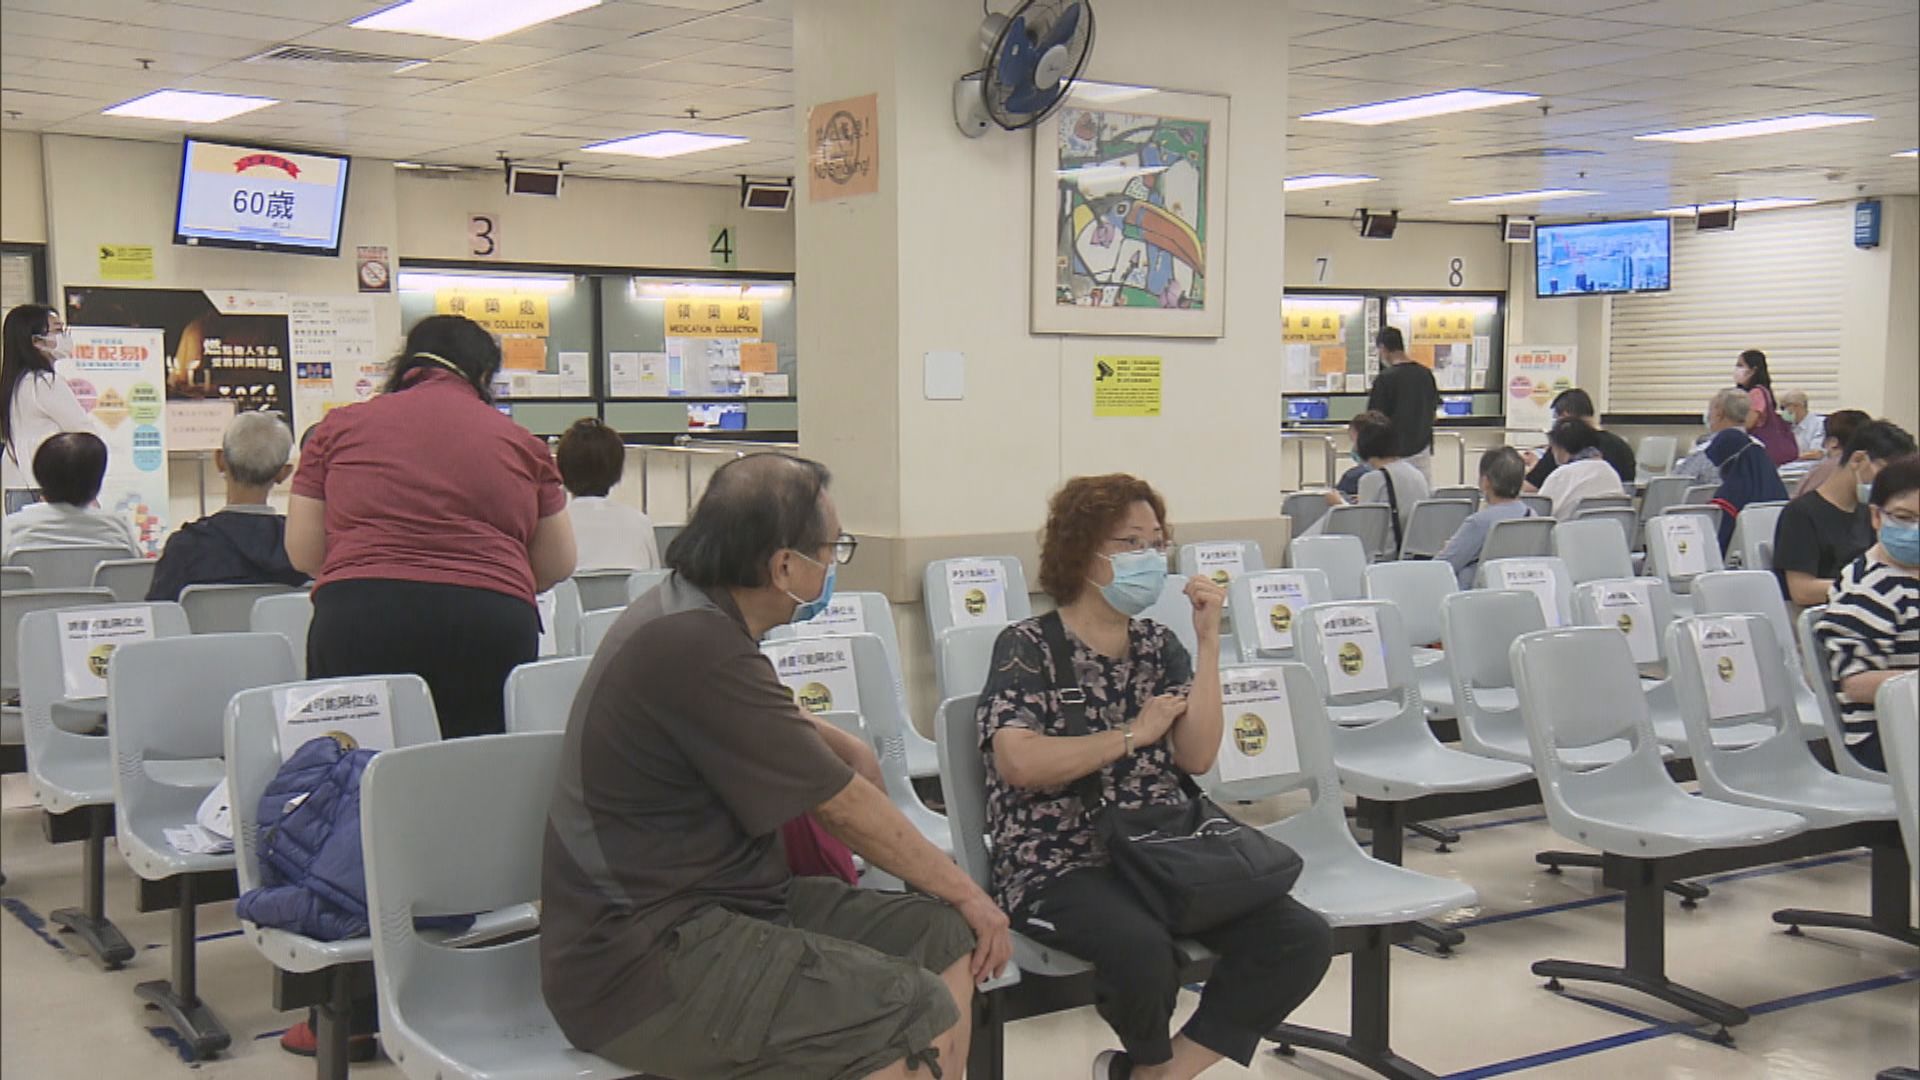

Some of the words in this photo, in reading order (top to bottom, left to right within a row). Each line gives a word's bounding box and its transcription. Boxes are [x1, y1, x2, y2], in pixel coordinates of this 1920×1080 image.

[233, 190, 295, 220] 60歲
[473, 216, 495, 256] 3
[710, 228, 733, 264] 4
[1316, 257, 1328, 281] 7
[1449, 257, 1463, 287] 8
[495, 320, 544, 328] COLLECTION
[669, 325, 712, 333] MEDICATION
[715, 325, 758, 333] COLLECTION
[1234, 725, 1265, 740] Thank
[1240, 738, 1262, 753] You!
